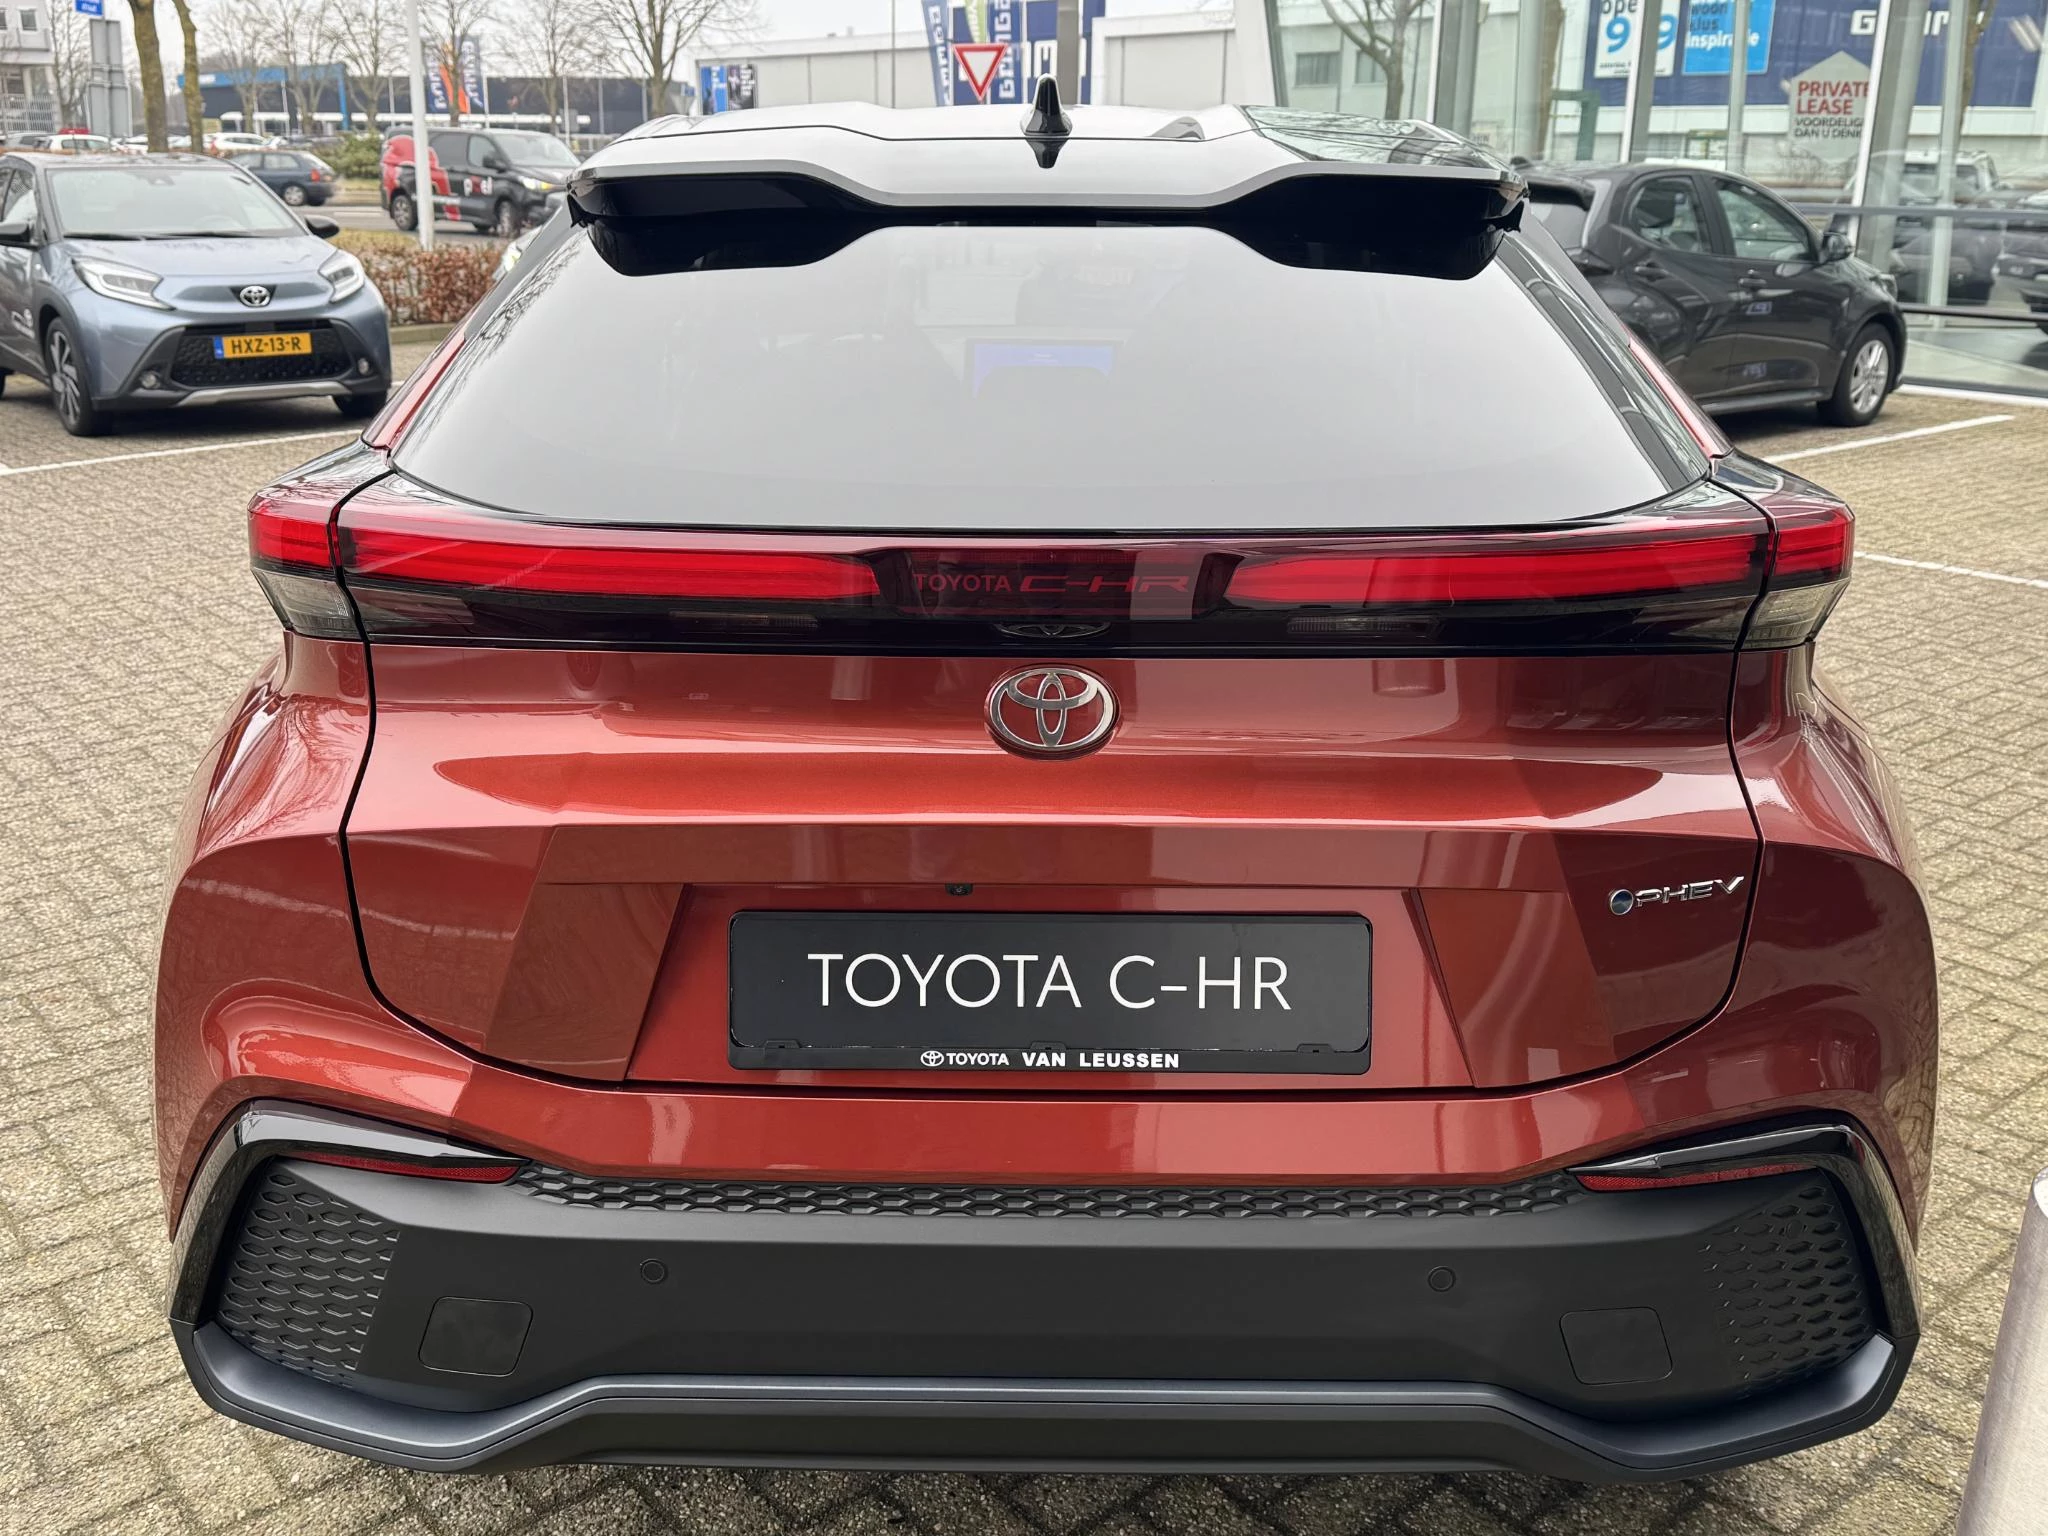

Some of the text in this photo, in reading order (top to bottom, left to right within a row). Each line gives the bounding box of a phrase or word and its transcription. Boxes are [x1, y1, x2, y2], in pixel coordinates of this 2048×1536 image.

[1606, 15, 1631, 53] 9
[1797, 99, 1853, 115] LEASE
[1795, 129, 1819, 137] DAN
[914, 574, 1188, 593] TOYOTA C-HR
[808, 954, 1292, 1011] TOYOTA C-HR
[946, 1052, 1179, 1068] TOYOTA VAN LEUSSEN
